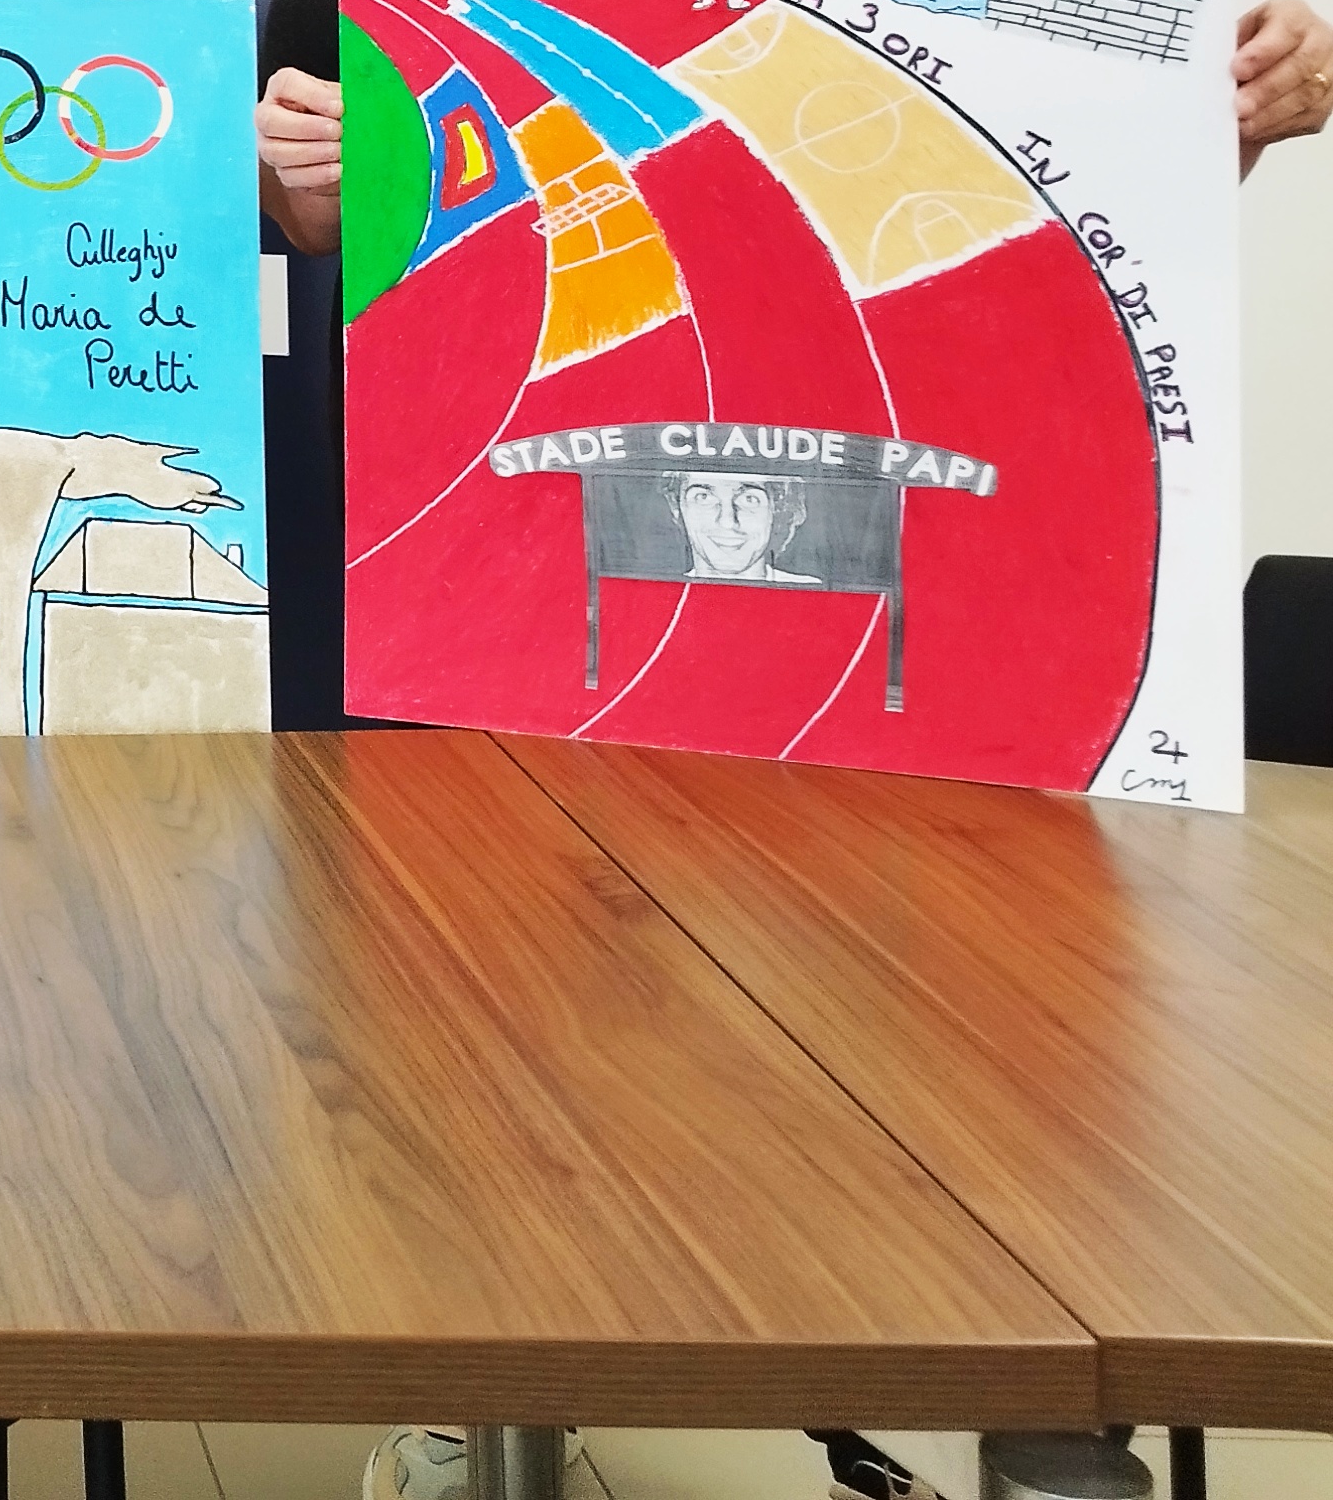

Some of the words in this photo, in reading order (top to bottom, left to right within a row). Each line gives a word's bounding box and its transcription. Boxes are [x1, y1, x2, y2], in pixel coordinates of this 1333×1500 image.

[844, 2, 880, 34] 3
[882, 32, 953, 86] ORI
[66, 221, 178, 283] Culleghju
[1, 275, 112, 331] Maria
[138, 291, 197, 329] de
[1016, 129, 1072, 187] IN
[1110, 282, 1158, 330] DI
[1144, 343, 1195, 445] PAESI
[84, 337, 199, 394] Peretti
[492, 426, 627, 478] STADE
[660, 422, 846, 465] CLAUDE
[879, 440, 998, 497] PAPI
